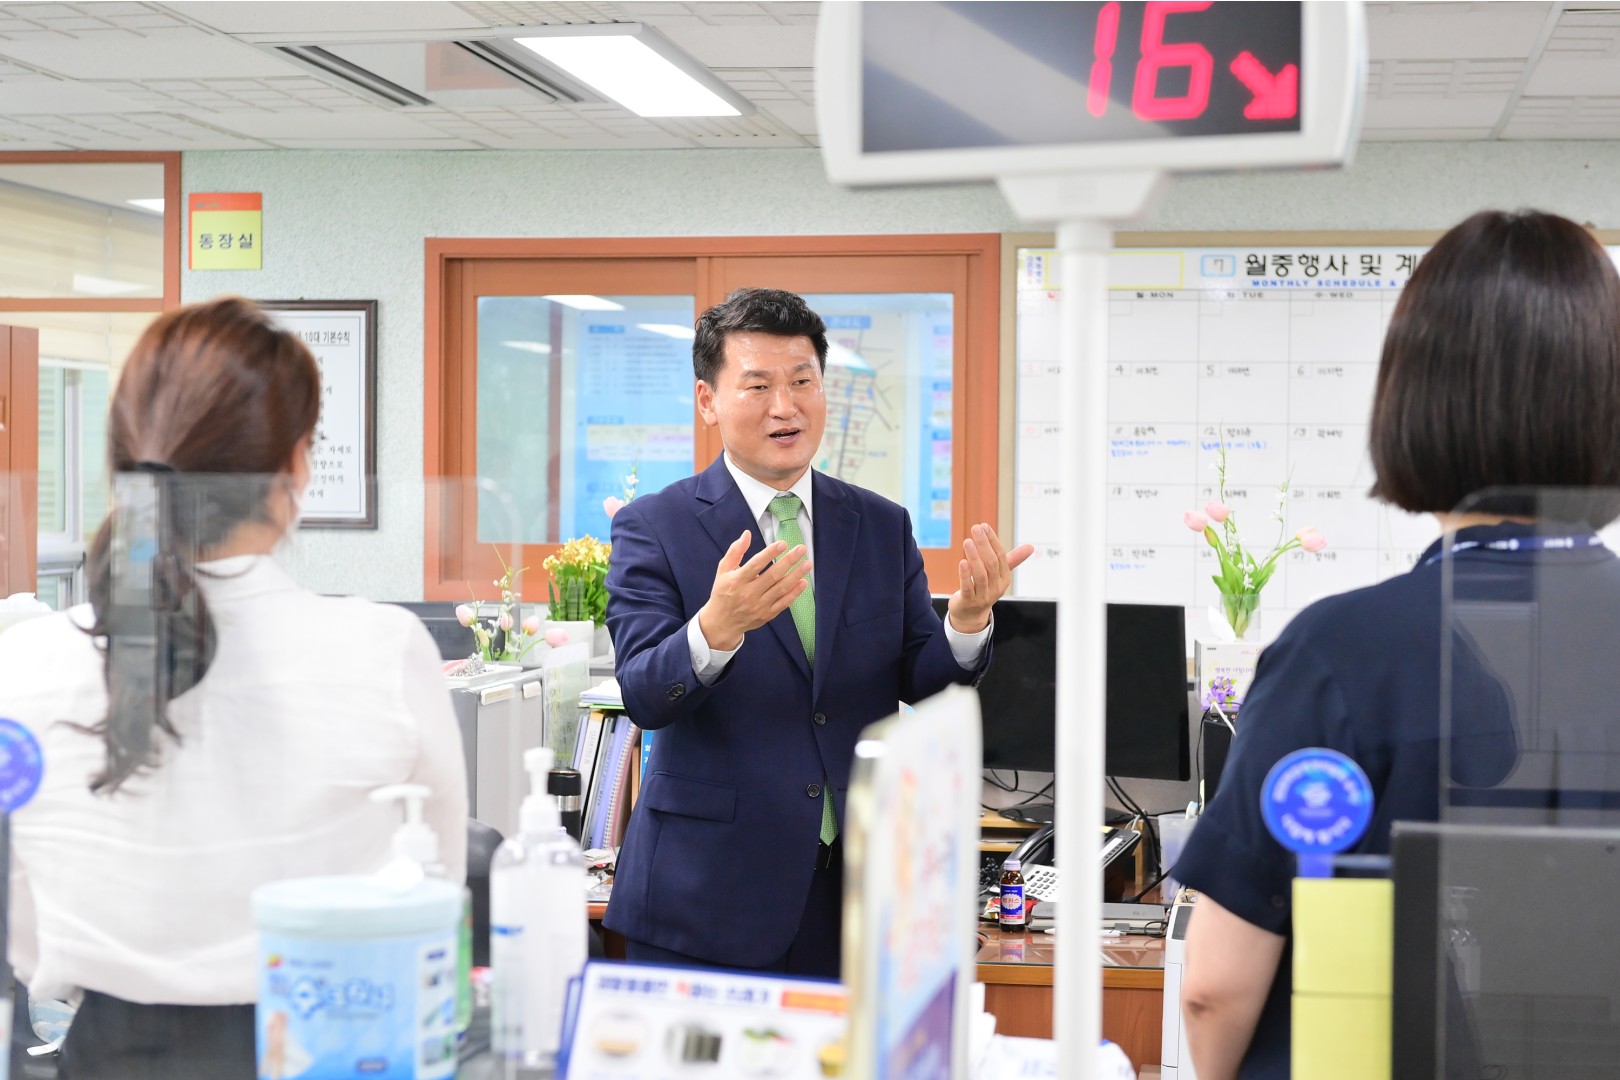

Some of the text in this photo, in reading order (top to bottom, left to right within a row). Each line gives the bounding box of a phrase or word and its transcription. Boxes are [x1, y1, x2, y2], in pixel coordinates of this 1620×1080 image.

[1087, 0, 1214, 121] 16
[199, 233, 253, 250] 통장실
[1244, 253, 1418, 278] 월중행사 및 계
[1251, 279, 1309, 288] MONTHLY
[1317, 279, 1382, 288] SCHEDULE
[1206, 364, 1215, 376] 5
[1297, 365, 1305, 376] 6
